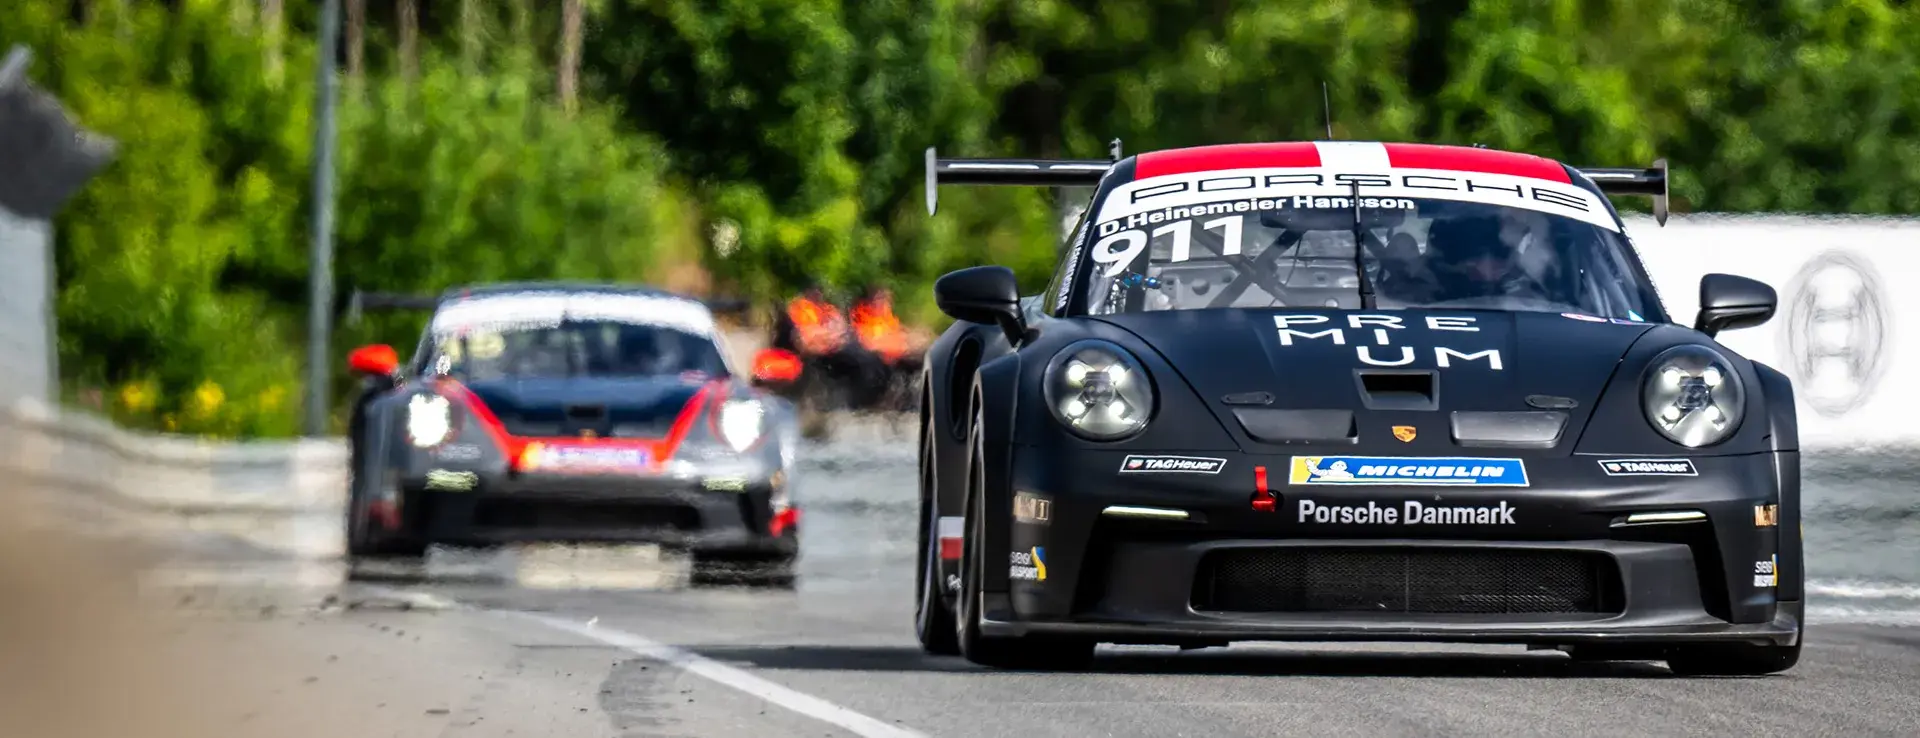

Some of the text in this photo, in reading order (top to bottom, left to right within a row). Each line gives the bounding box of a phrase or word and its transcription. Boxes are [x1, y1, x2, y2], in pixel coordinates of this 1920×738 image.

[1130, 173, 1590, 213] PORSCHE
[1099, 199, 1287, 238] D.Heinemeier
[1091, 215, 1243, 278] 911
[1357, 465, 1505, 478] MICHELIN
[1298, 500, 1516, 525] Porsche Danmark
